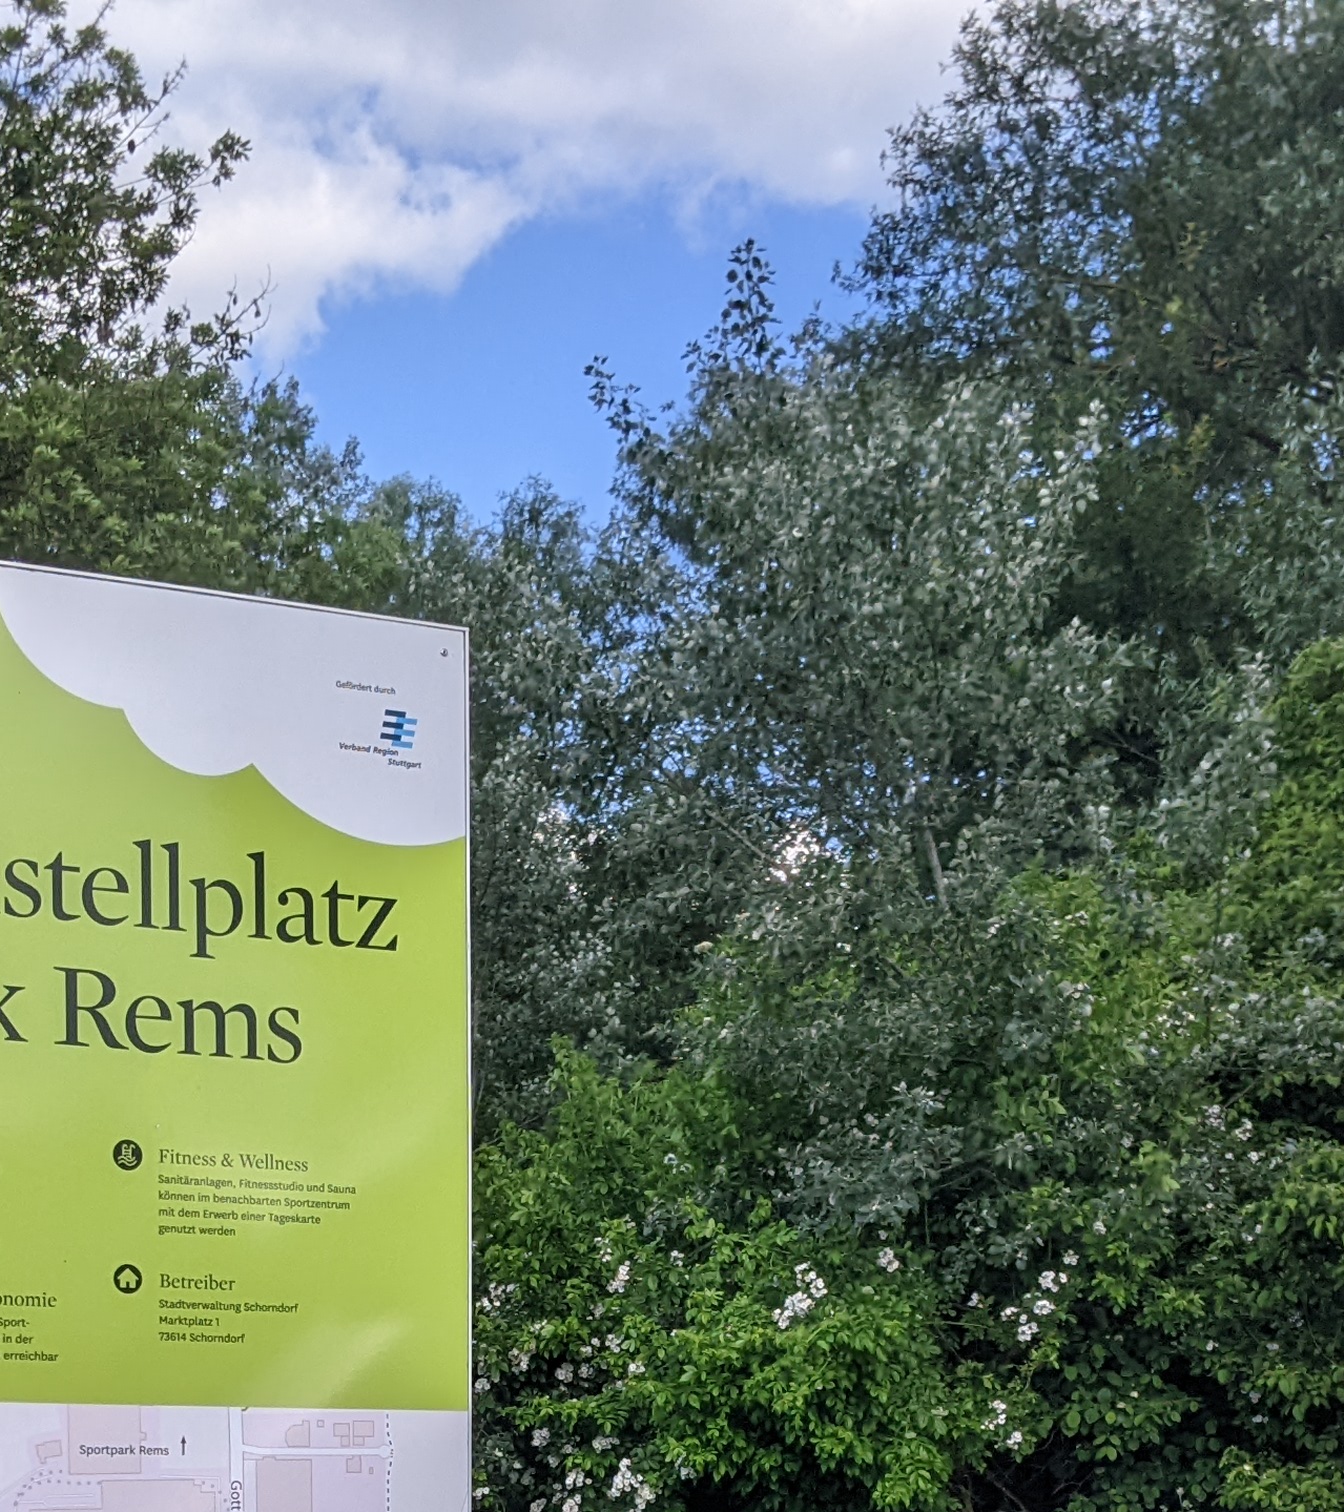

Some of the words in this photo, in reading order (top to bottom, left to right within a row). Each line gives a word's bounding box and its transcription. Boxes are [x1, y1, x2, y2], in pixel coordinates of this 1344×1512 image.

[336, 681, 372, 692] Gefördert
[374, 685, 396, 694] durch
[339, 742, 371, 753] Verband
[373, 747, 398, 756] Region
[388, 758, 421, 769] Stuttgart
[54, 967, 302, 1064] Rems
[159, 1149, 216, 1167] Fitness
[221, 1153, 234, 1167] &
[239, 1154, 308, 1172] Wellness
[159, 1274, 236, 1291] Betreiber
[159, 1300, 241, 1313] Stadtverwaltung
[243, 1302, 298, 1313] Schorndorf
[79, 1443, 136, 1458] Sportpark
[139, 1444, 169, 1457] Rems
